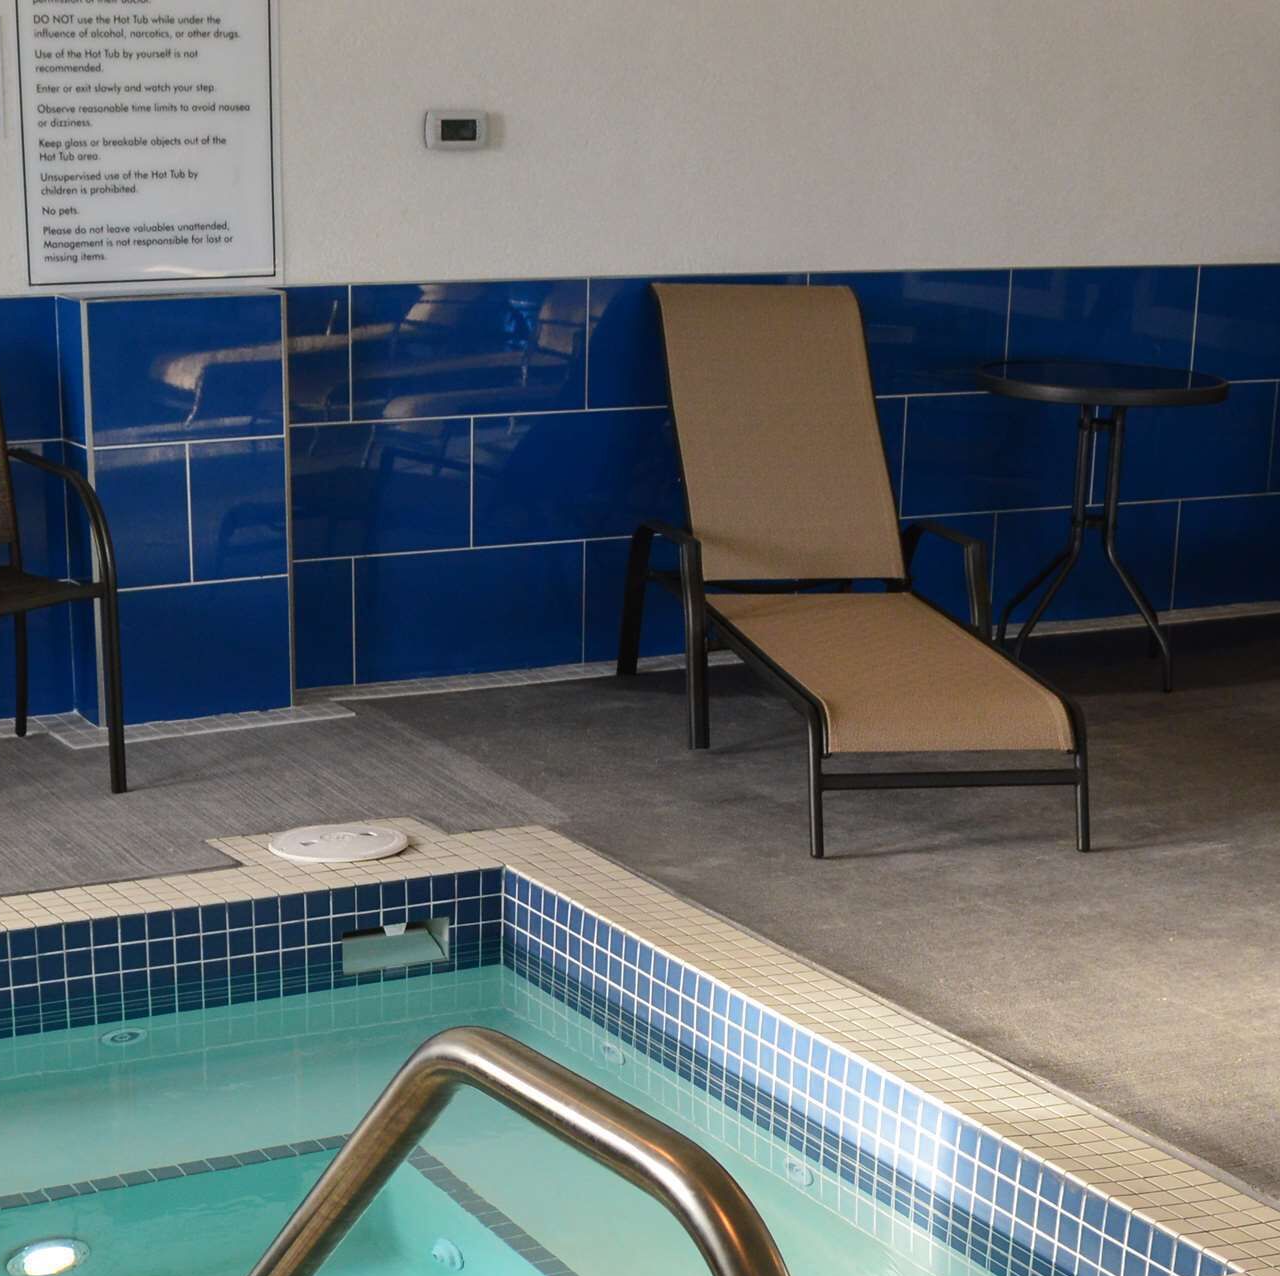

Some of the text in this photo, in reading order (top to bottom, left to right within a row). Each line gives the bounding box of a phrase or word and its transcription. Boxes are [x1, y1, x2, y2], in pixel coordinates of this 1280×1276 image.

[33, 14, 221, 24] DO NOT use the Hot Tub while under the
[34, 27, 76, 38] influence
[78, 27, 88, 38] of
[175, 30, 184, 38] or
[187, 28, 210, 38] other
[34, 48, 198, 60] Use of the Hot Tub by yourself is not
[36, 83, 60, 93] Enter
[75, 84, 91, 93] exit
[94, 82, 121, 95] slowly
[123, 82, 142, 93] and
[144, 82, 171, 93] watch
[173, 85, 192, 95] your
[37, 102, 250, 114] Observe reasonable time limits to avoid nausea
[37, 120, 47, 128] or
[38, 135, 227, 150] Keep glass or breakable objects out of the
[39, 151, 56, 162] Hot
[58, 150, 75, 161] Tub
[40, 171, 101, 183] Unsupervised
[122, 170, 132, 180] of
[134, 170, 149, 180] the
[151, 170, 168, 180] Hot
[170, 169, 186, 180] Tub
[187, 168, 199, 181] by
[40, 185, 78, 196] children
[80, 184, 88, 195] is
[42, 206, 56, 216] No
[42, 225, 73, 236] Please
[74, 224, 87, 235] do
[89, 226, 104, 234] not
[106, 223, 131, 234] leave
[133, 222, 175, 233] valuables
[43, 239, 104, 251] Management
[106, 237, 114, 248] is
[115, 237, 130, 247] not
[191, 233, 204, 245] for
[206, 233, 221, 244] lost
[223, 236, 233, 244] or
[44, 253, 78, 265] missing
